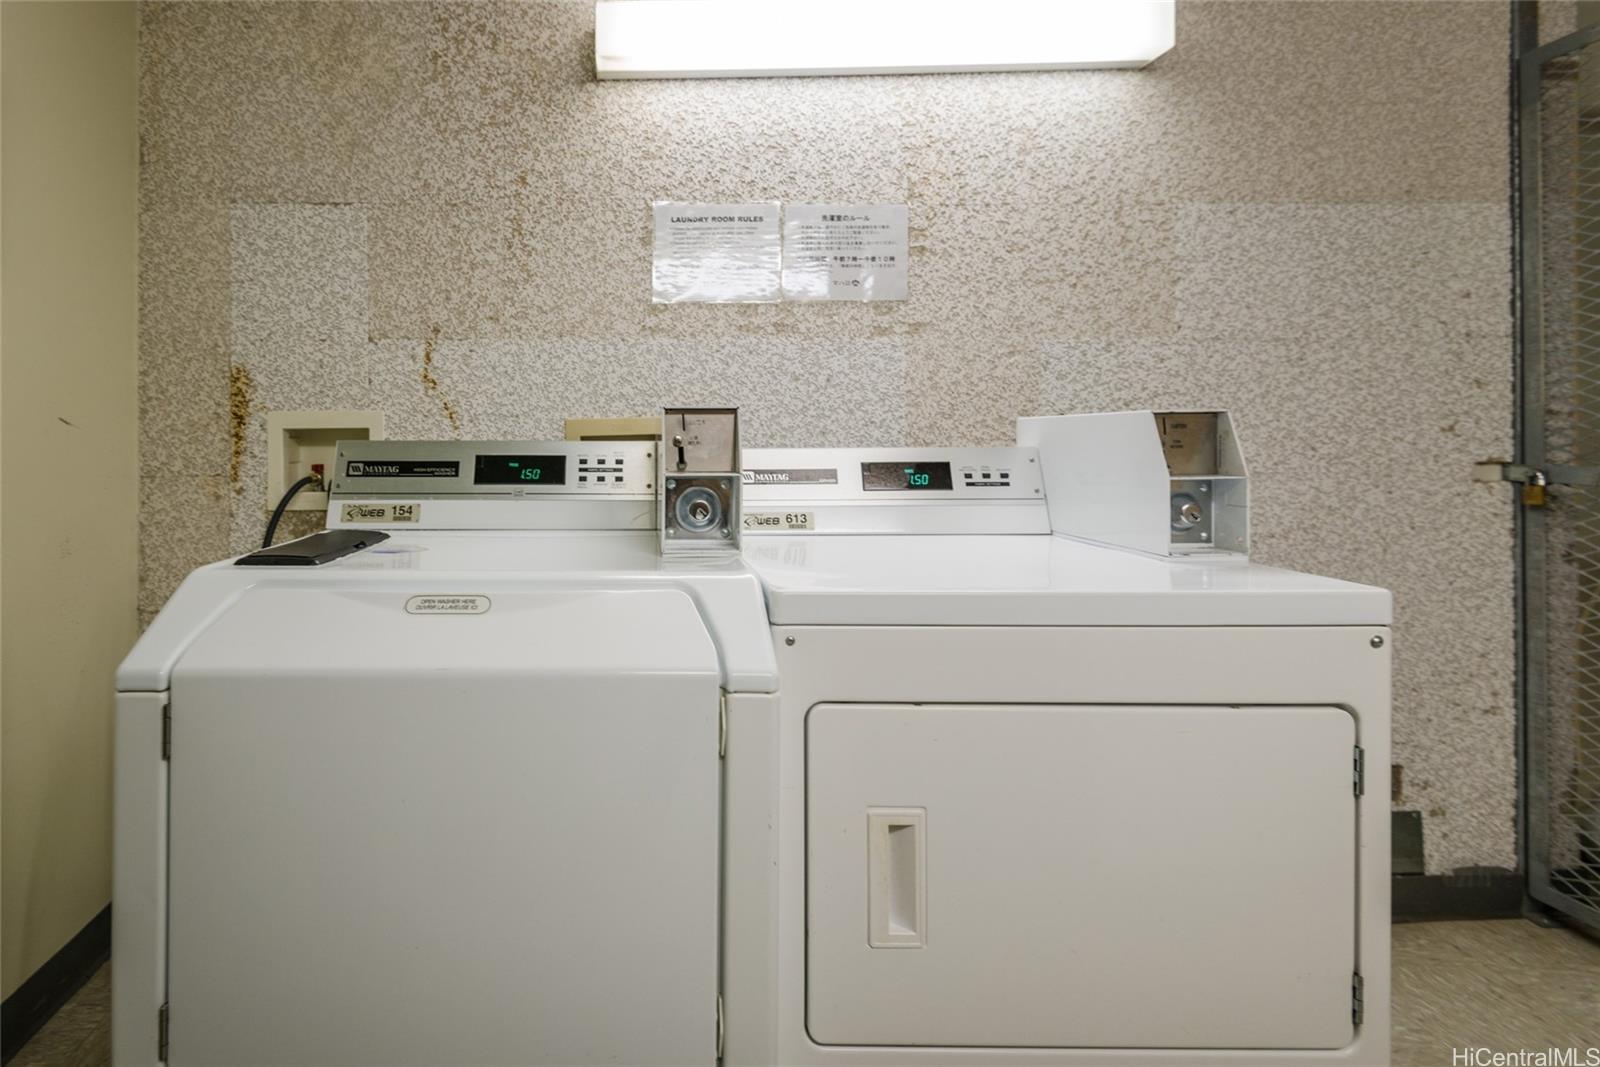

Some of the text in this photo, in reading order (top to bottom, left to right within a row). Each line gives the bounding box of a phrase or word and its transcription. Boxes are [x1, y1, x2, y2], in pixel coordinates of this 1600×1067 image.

[364, 465, 400, 473] MAYTAG
[755, 473, 790, 481] MAYTAG
[359, 505, 413, 518] WEB 154
[757, 517, 781, 526] WEB
[785, 513, 808, 524] 613
